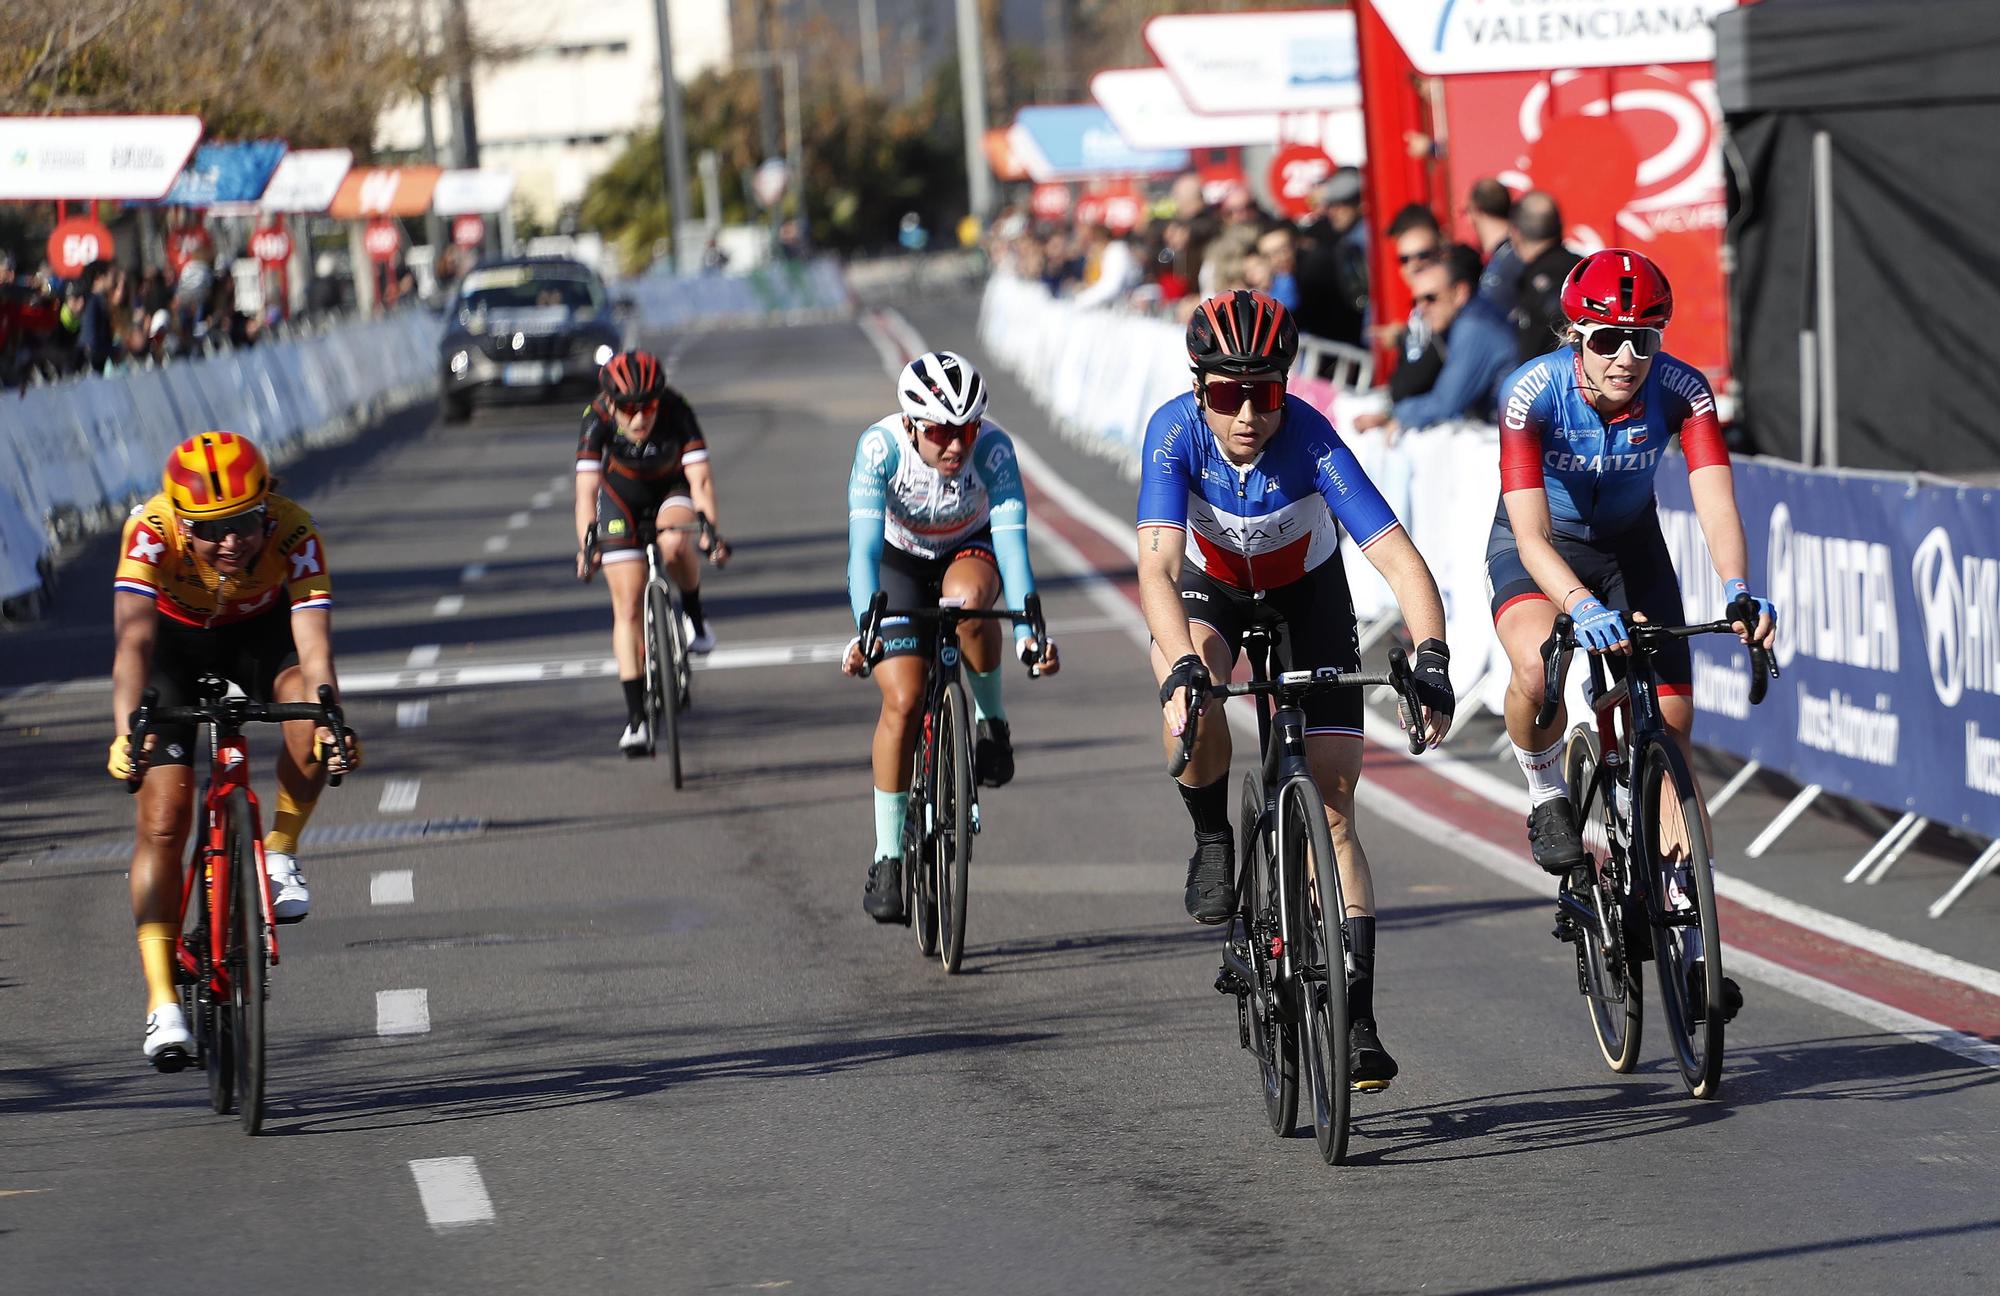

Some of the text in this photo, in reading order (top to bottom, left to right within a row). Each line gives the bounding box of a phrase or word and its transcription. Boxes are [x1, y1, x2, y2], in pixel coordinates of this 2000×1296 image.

[1463, 7, 1709, 43] VALENCIANA
[62, 234, 99, 267] 50
[1544, 449, 1658, 473] CERATIZIT
